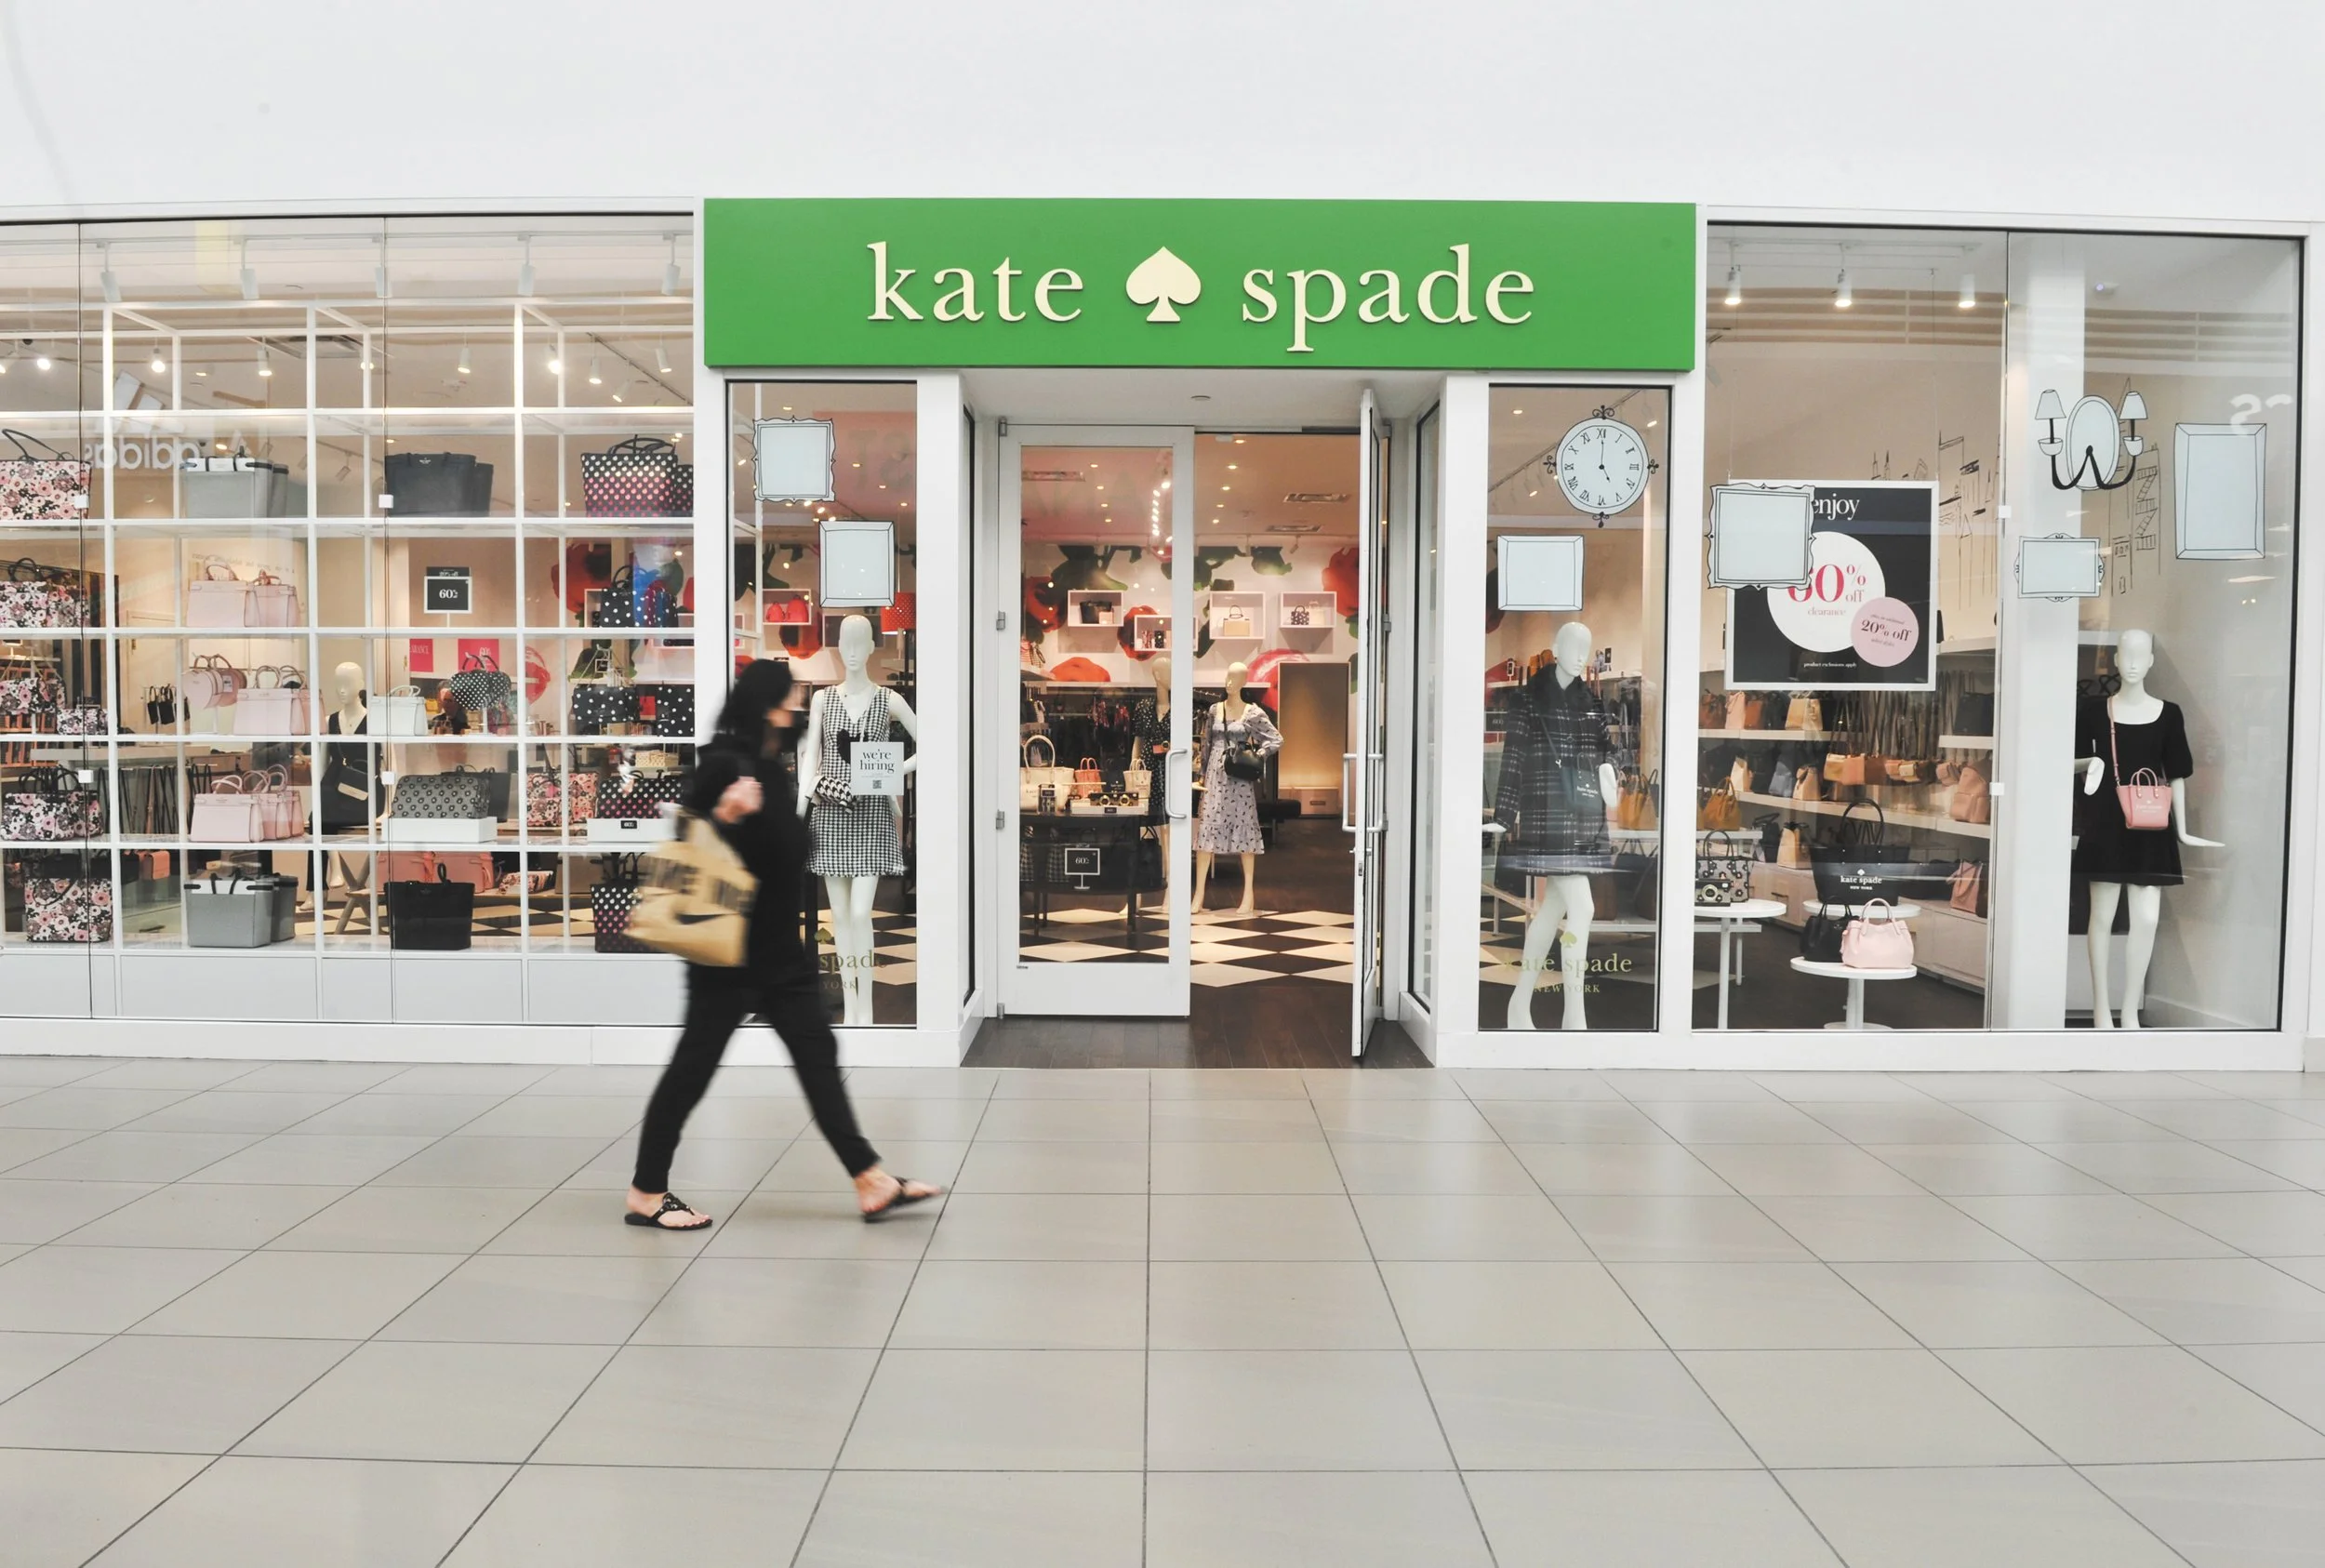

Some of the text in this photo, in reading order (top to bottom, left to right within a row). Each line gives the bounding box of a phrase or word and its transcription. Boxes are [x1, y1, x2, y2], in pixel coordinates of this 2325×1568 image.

[867, 240, 1534, 353] kate spade
[1813, 493, 1860, 521] enjoy
[1845, 589, 1865, 603] off
[1808, 608, 1846, 617] clearance
[1861, 618, 1890, 637] 20%
[1893, 629, 1912, 642] off
[862, 749, 892, 760] we're
[859, 759, 895, 773] hiring
[1840, 875, 1882, 885] kate spade
[1564, 952, 1632, 978] spade
[1534, 984, 1601, 993] NEW YORK
